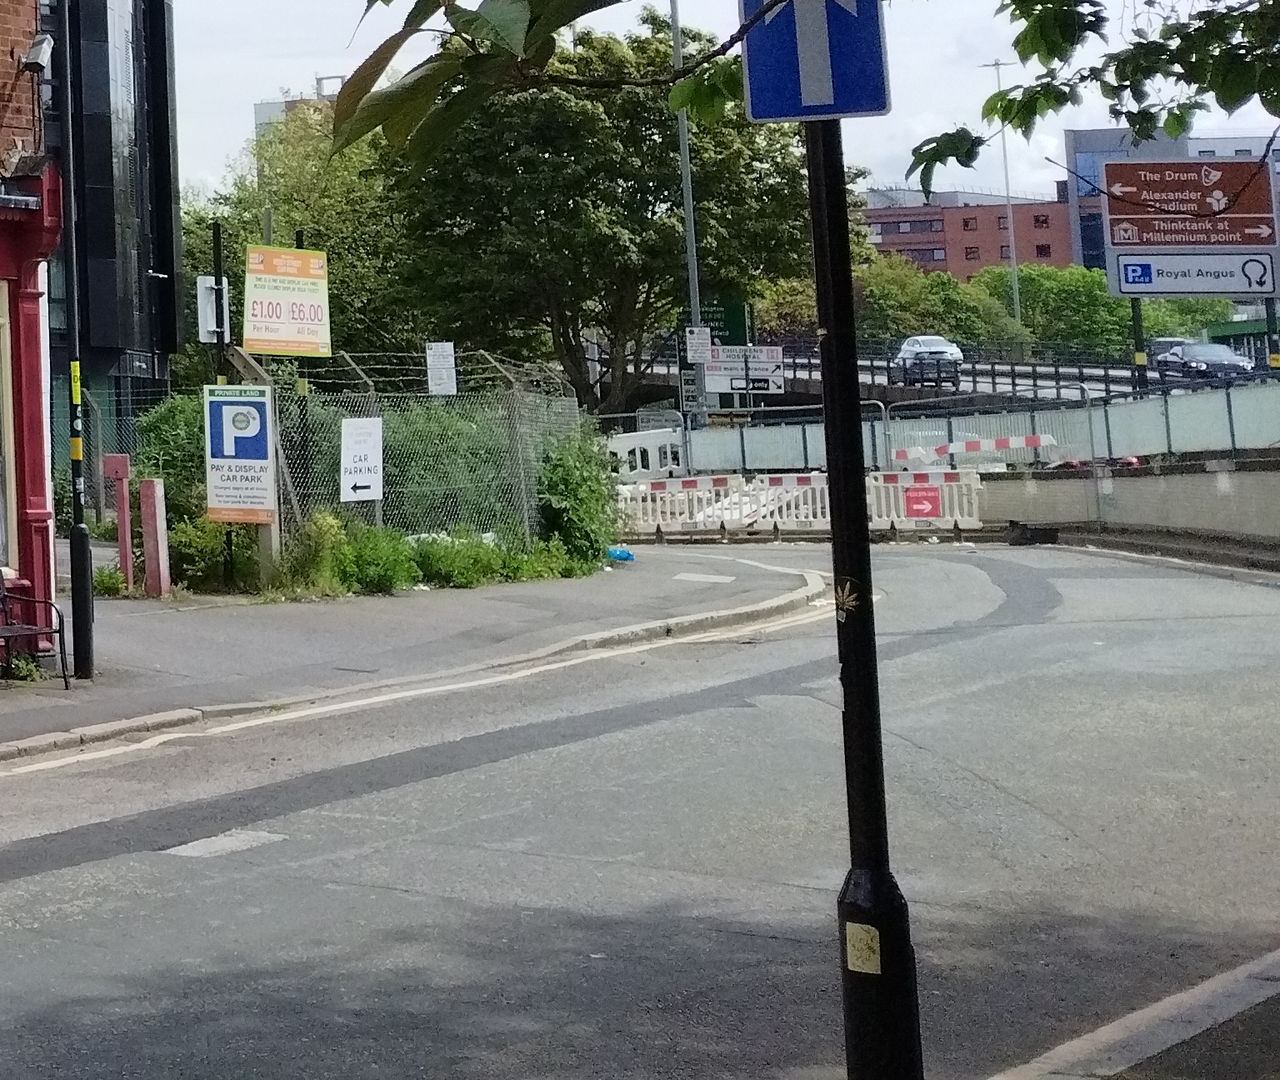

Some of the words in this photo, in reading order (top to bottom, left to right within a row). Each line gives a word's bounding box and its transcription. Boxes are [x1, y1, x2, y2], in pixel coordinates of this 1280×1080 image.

[1138, 171, 1161, 181] The
[1165, 171, 1198, 181] Drum
[1141, 191, 1202, 200] Alexander
[1153, 220, 1213, 230] Thinktank
[1217, 221, 1230, 230] at
[1143, 232, 1208, 242] Millennium
[1210, 232, 1242, 244] point
[1127, 266, 1143, 283] P
[1156, 269, 1191, 280] Royal
[1196, 269, 1236, 280] Angus
[251, 300, 283, 319] £1.00
[291, 302, 324, 322] £6.00
[222, 405, 260, 456] P
[352, 454, 369, 464] CAR
[210, 465, 225, 473] PAY
[226, 465, 233, 473] &
[235, 465, 269, 473] DISPLAY
[343, 465, 379, 476] PARKING
[220, 474, 238, 482] CAR
[239, 475, 263, 483] PARK
